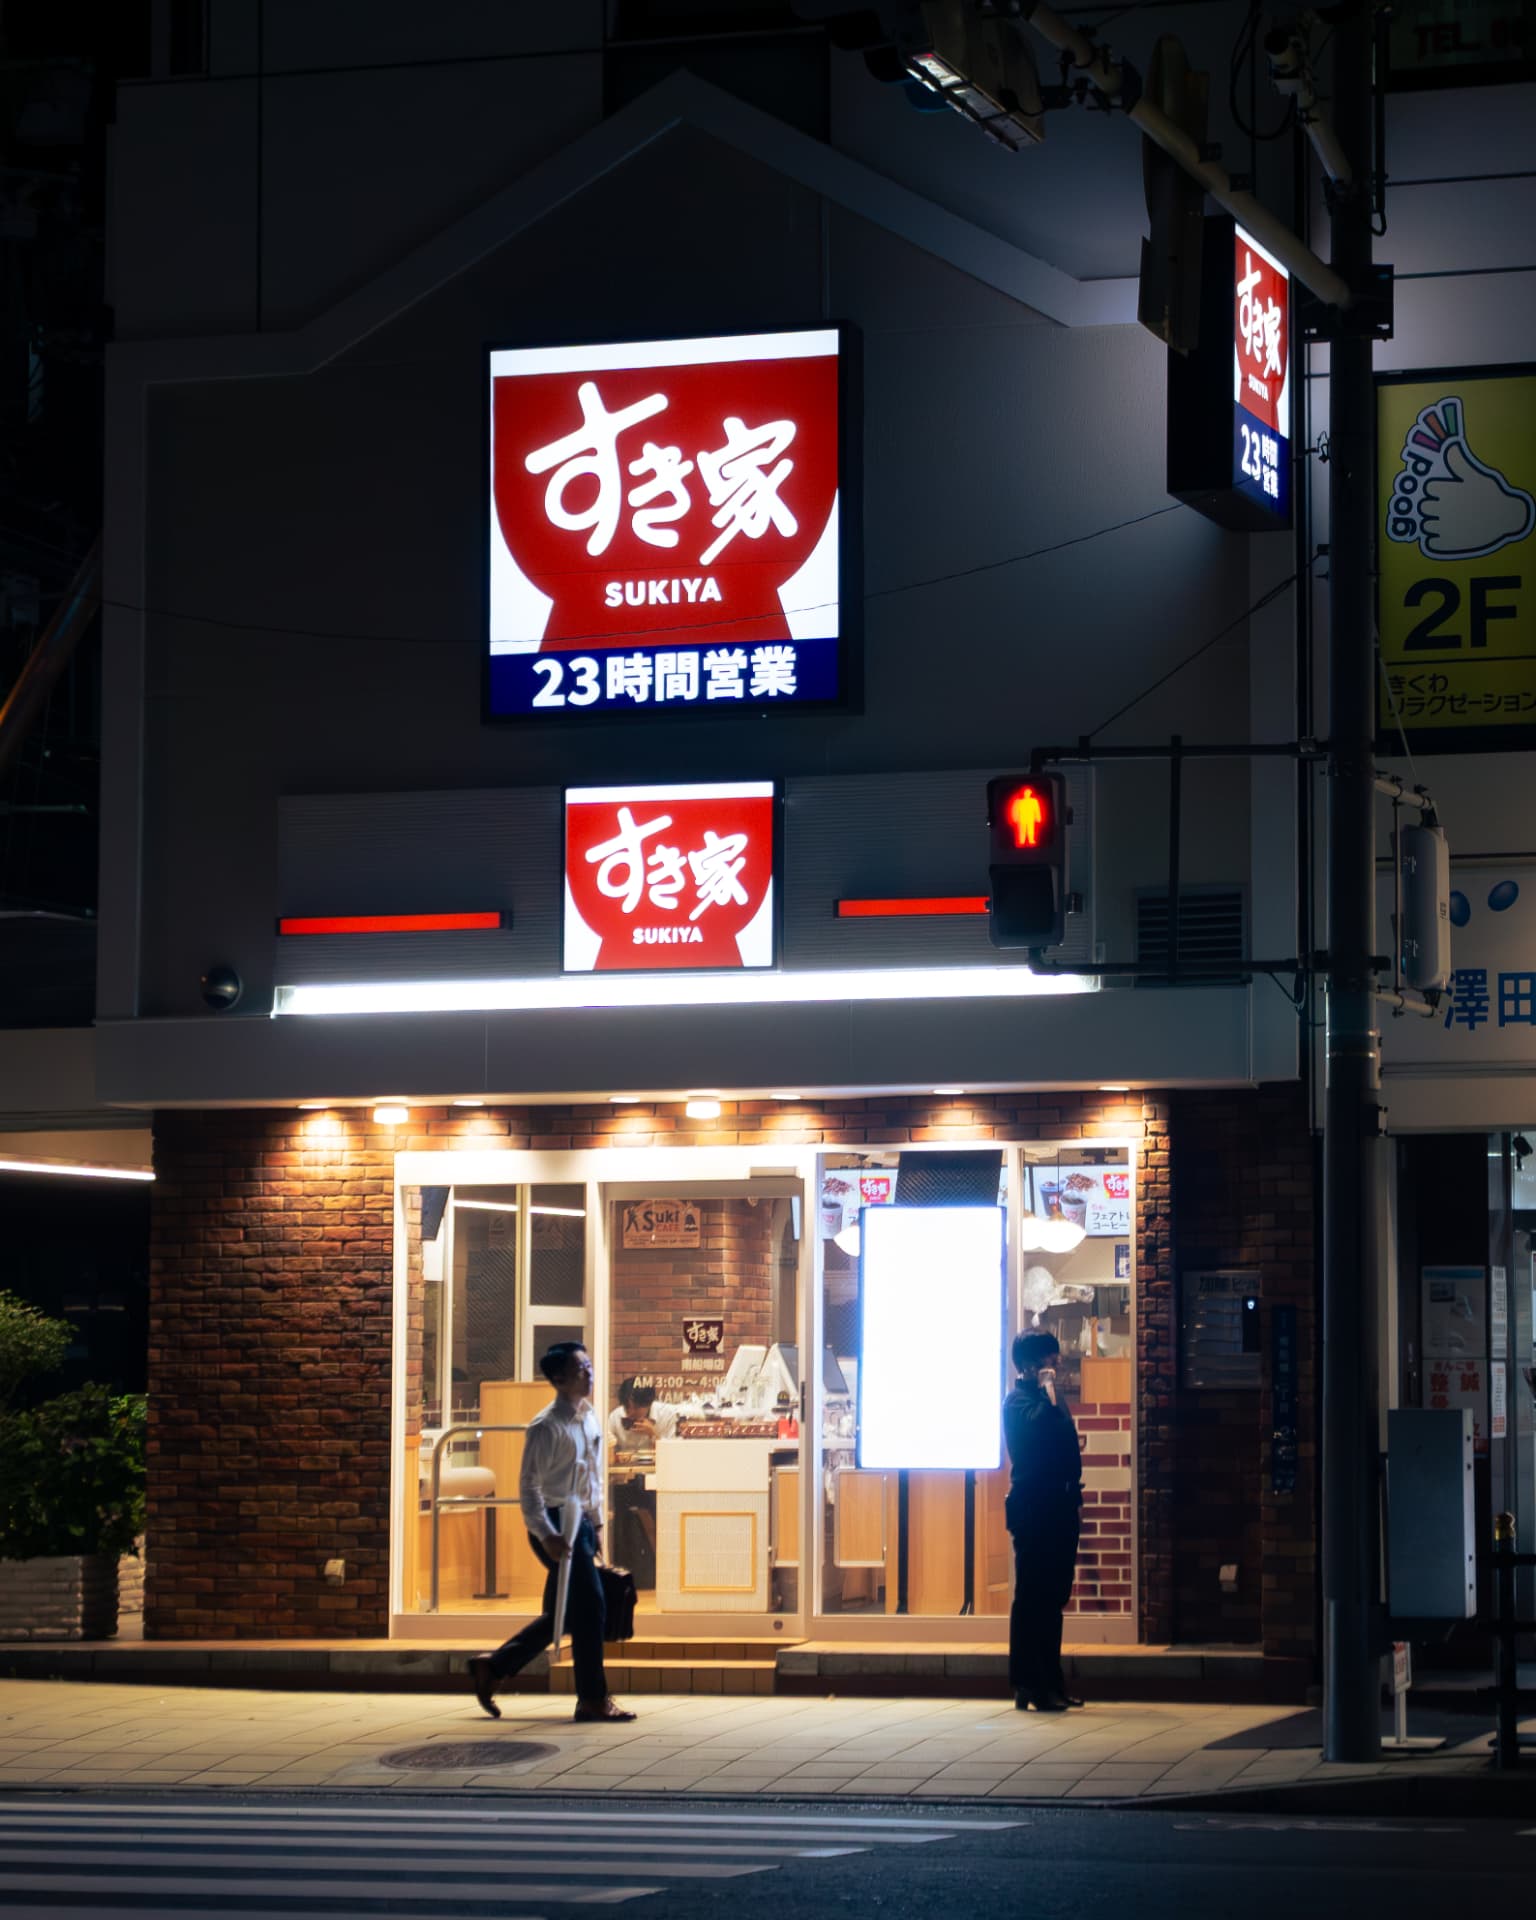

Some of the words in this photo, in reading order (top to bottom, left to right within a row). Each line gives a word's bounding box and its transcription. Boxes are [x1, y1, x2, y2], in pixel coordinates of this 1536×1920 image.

[1236, 251, 1281, 379] すき家
[524, 381, 798, 566] すき家
[1241, 423, 1261, 481] 23
[1392, 451, 1433, 536] good
[604, 577, 722, 607] SUKIYA
[1403, 575, 1522, 652] 2F
[531, 645, 798, 707] 23時間営業
[585, 807, 749, 921] すき家
[632, 926, 703, 944] SUKIYA
